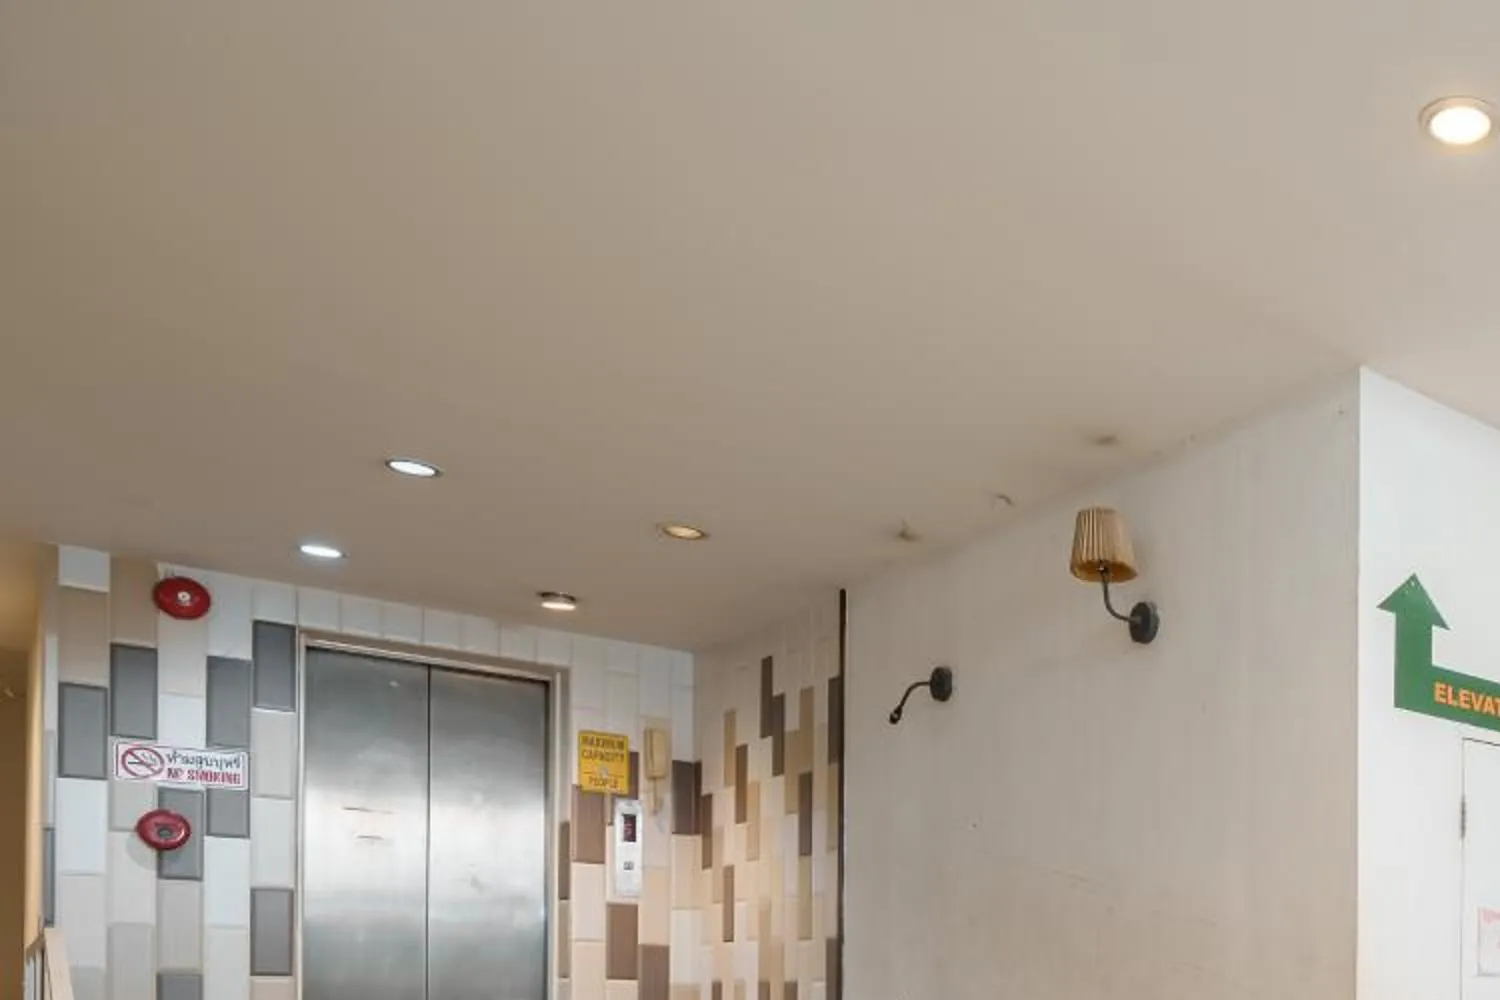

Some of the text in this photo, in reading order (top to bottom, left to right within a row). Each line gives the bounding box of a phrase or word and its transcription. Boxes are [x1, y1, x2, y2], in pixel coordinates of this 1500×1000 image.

[580, 748, 625, 763] CAPACITY
[166, 767, 241, 785] NO SMOKING
